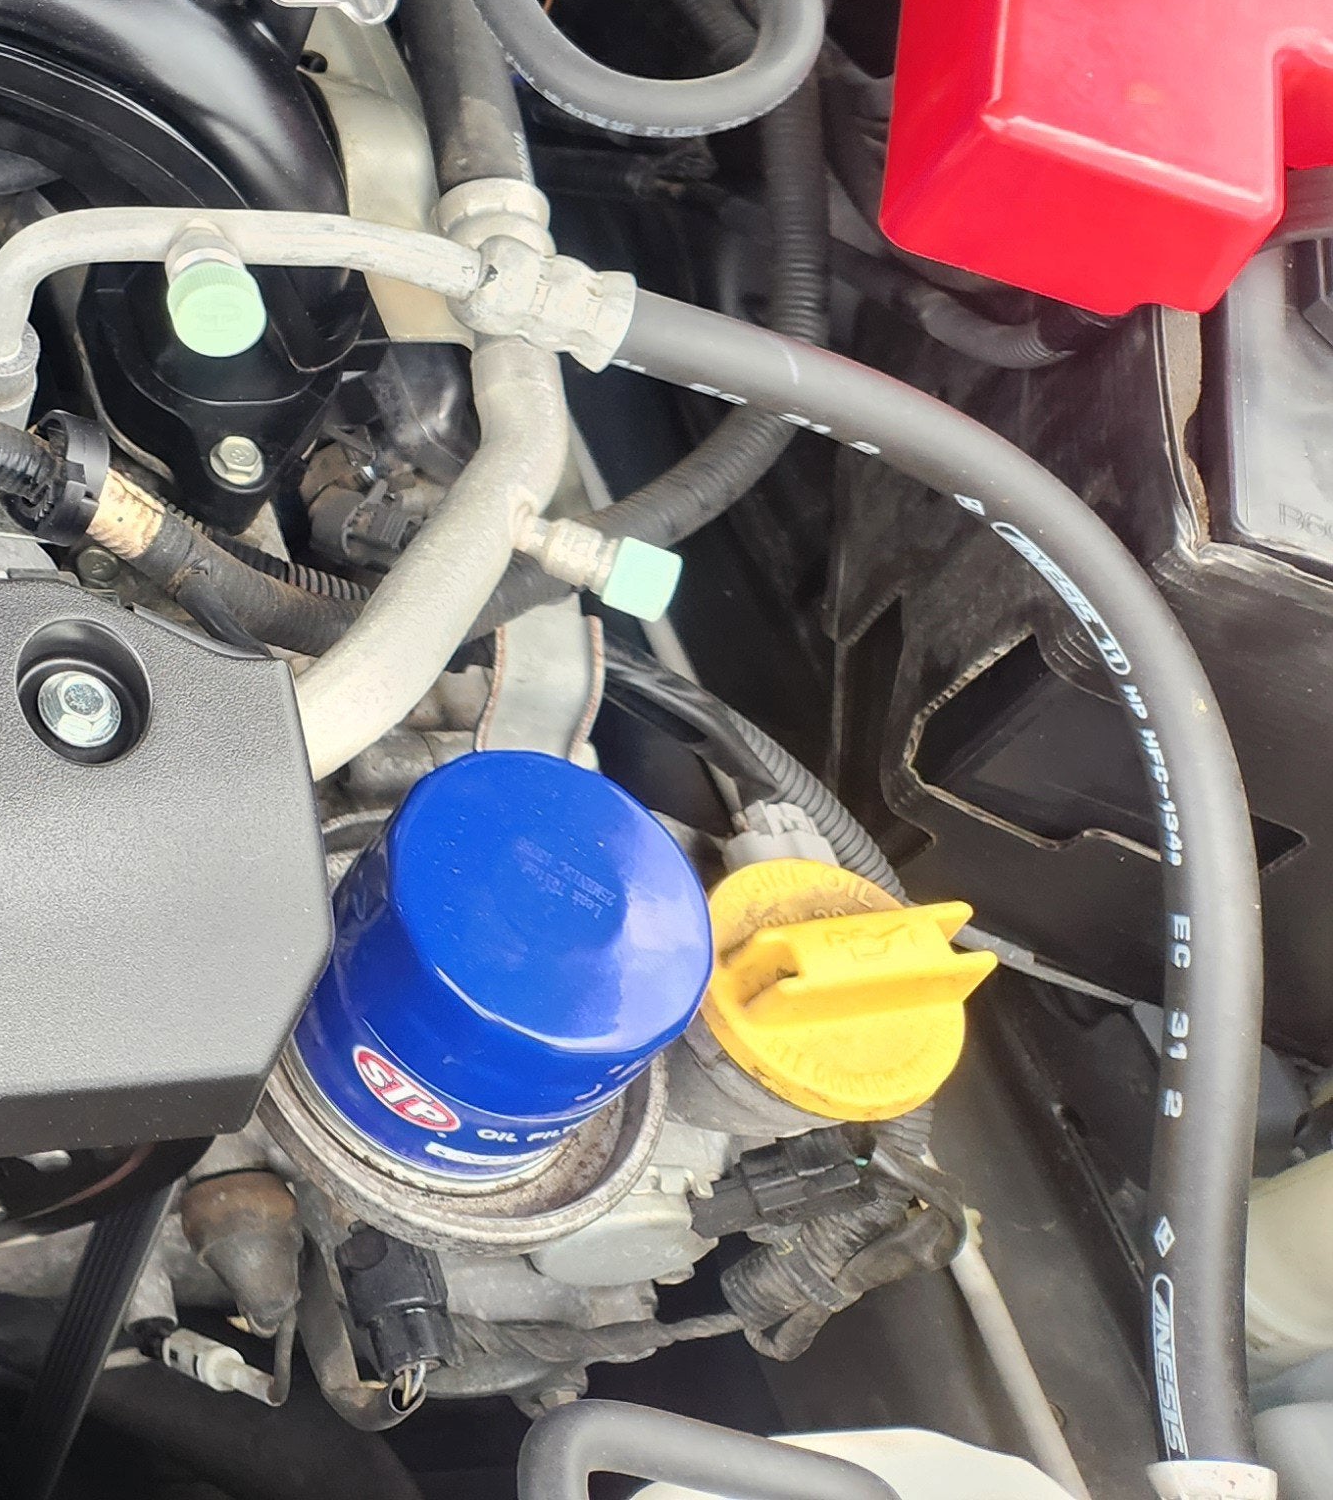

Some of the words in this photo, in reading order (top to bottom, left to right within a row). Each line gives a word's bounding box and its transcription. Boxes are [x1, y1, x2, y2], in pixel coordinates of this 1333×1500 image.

[1119, 683, 1148, 720] HP
[1168, 913, 1191, 969] EC
[1166, 1010, 1190, 1060] 31
[356, 1056, 451, 1126] STP
[1162, 1088, 1183, 1119] 2
[476, 1127, 519, 1143] OIL
